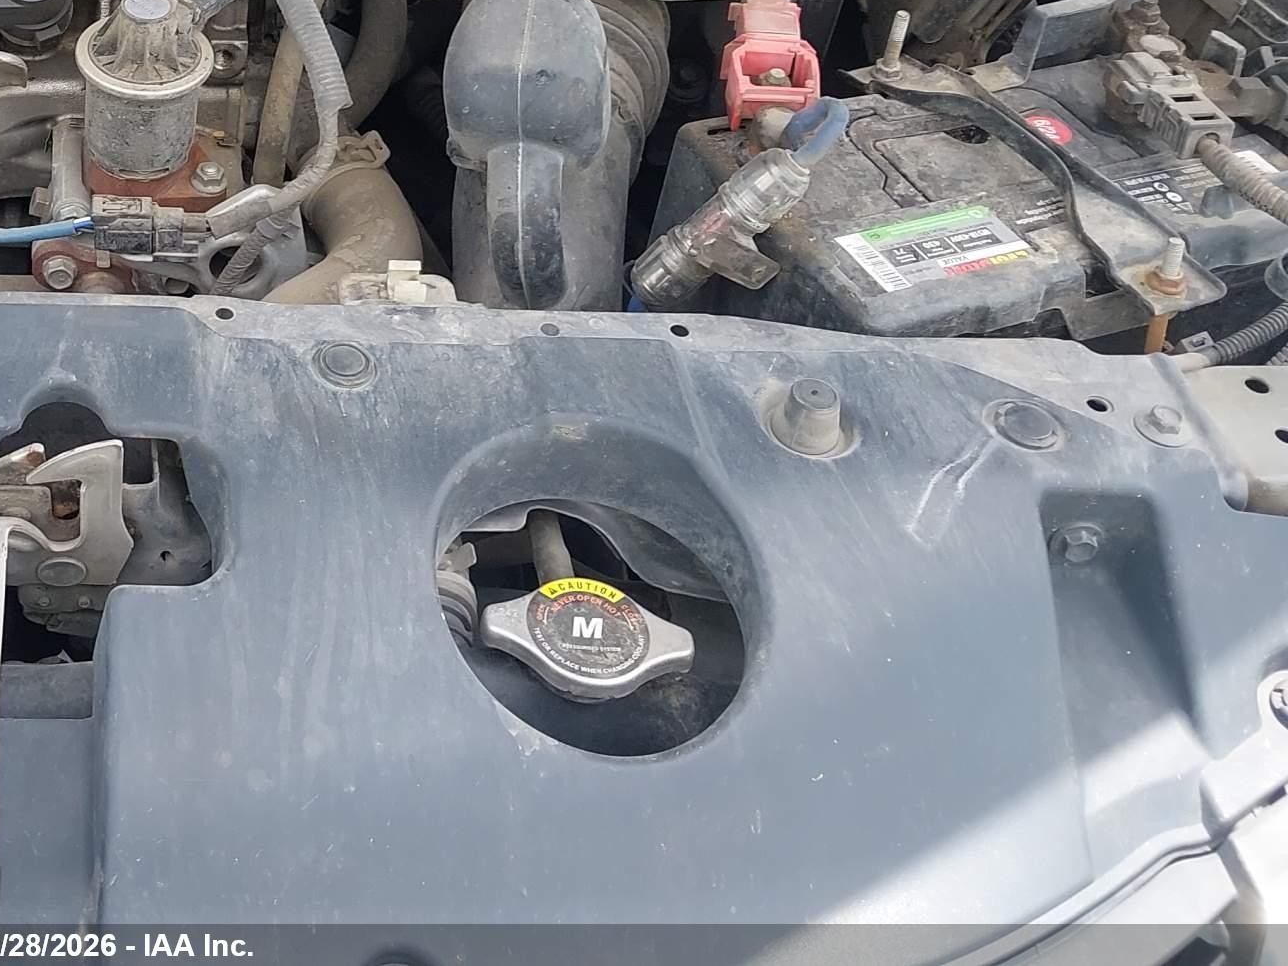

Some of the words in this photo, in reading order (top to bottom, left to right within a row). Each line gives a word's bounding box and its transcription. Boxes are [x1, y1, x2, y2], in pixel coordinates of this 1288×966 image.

[559, 582, 617, 601] CAUTION
[551, 595, 576, 614] NEVER
[576, 594, 603, 607] OPEN
[604, 601, 621, 617] HOT
[572, 616, 604, 639] M
[533, 627, 543, 642] TEST
[541, 640, 550, 651] OR
[548, 649, 580, 670] REPLACE
[580, 664, 602, 674] WHEN
[602, 657, 635, 673] CHANGING
[631, 634, 646, 661] COOLANT
